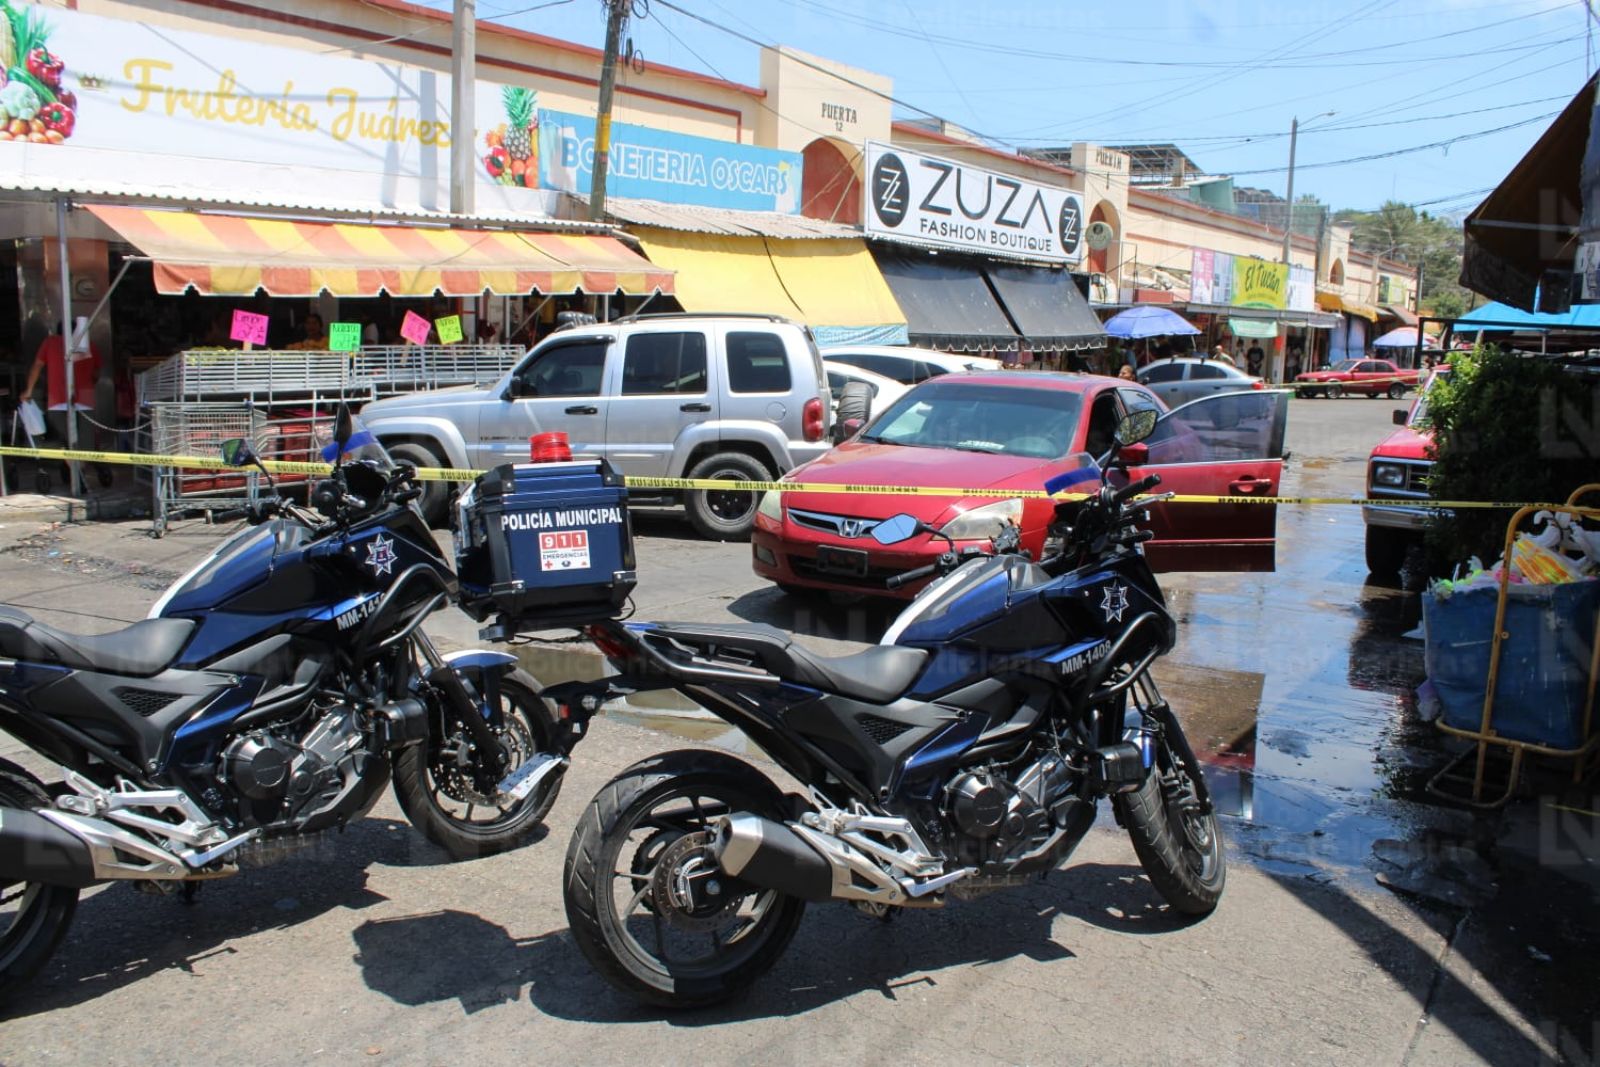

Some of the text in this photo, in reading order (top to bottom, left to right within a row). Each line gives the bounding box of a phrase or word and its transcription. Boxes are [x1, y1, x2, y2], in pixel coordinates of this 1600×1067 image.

[120, 58, 453, 148] Frutería Juárez
[821, 101, 858, 124] PUERTA
[711, 157, 788, 196] OSCARS
[919, 158, 1053, 234] ZUZA
[919, 217, 1052, 252] FASHION BOUTIQUE
[1245, 265, 1256, 292] El
[501, 507, 622, 531] POLICÍA MUNICIPAL
[544, 533, 584, 549] 911
[542, 551, 588, 560] EMERGENCIAS
